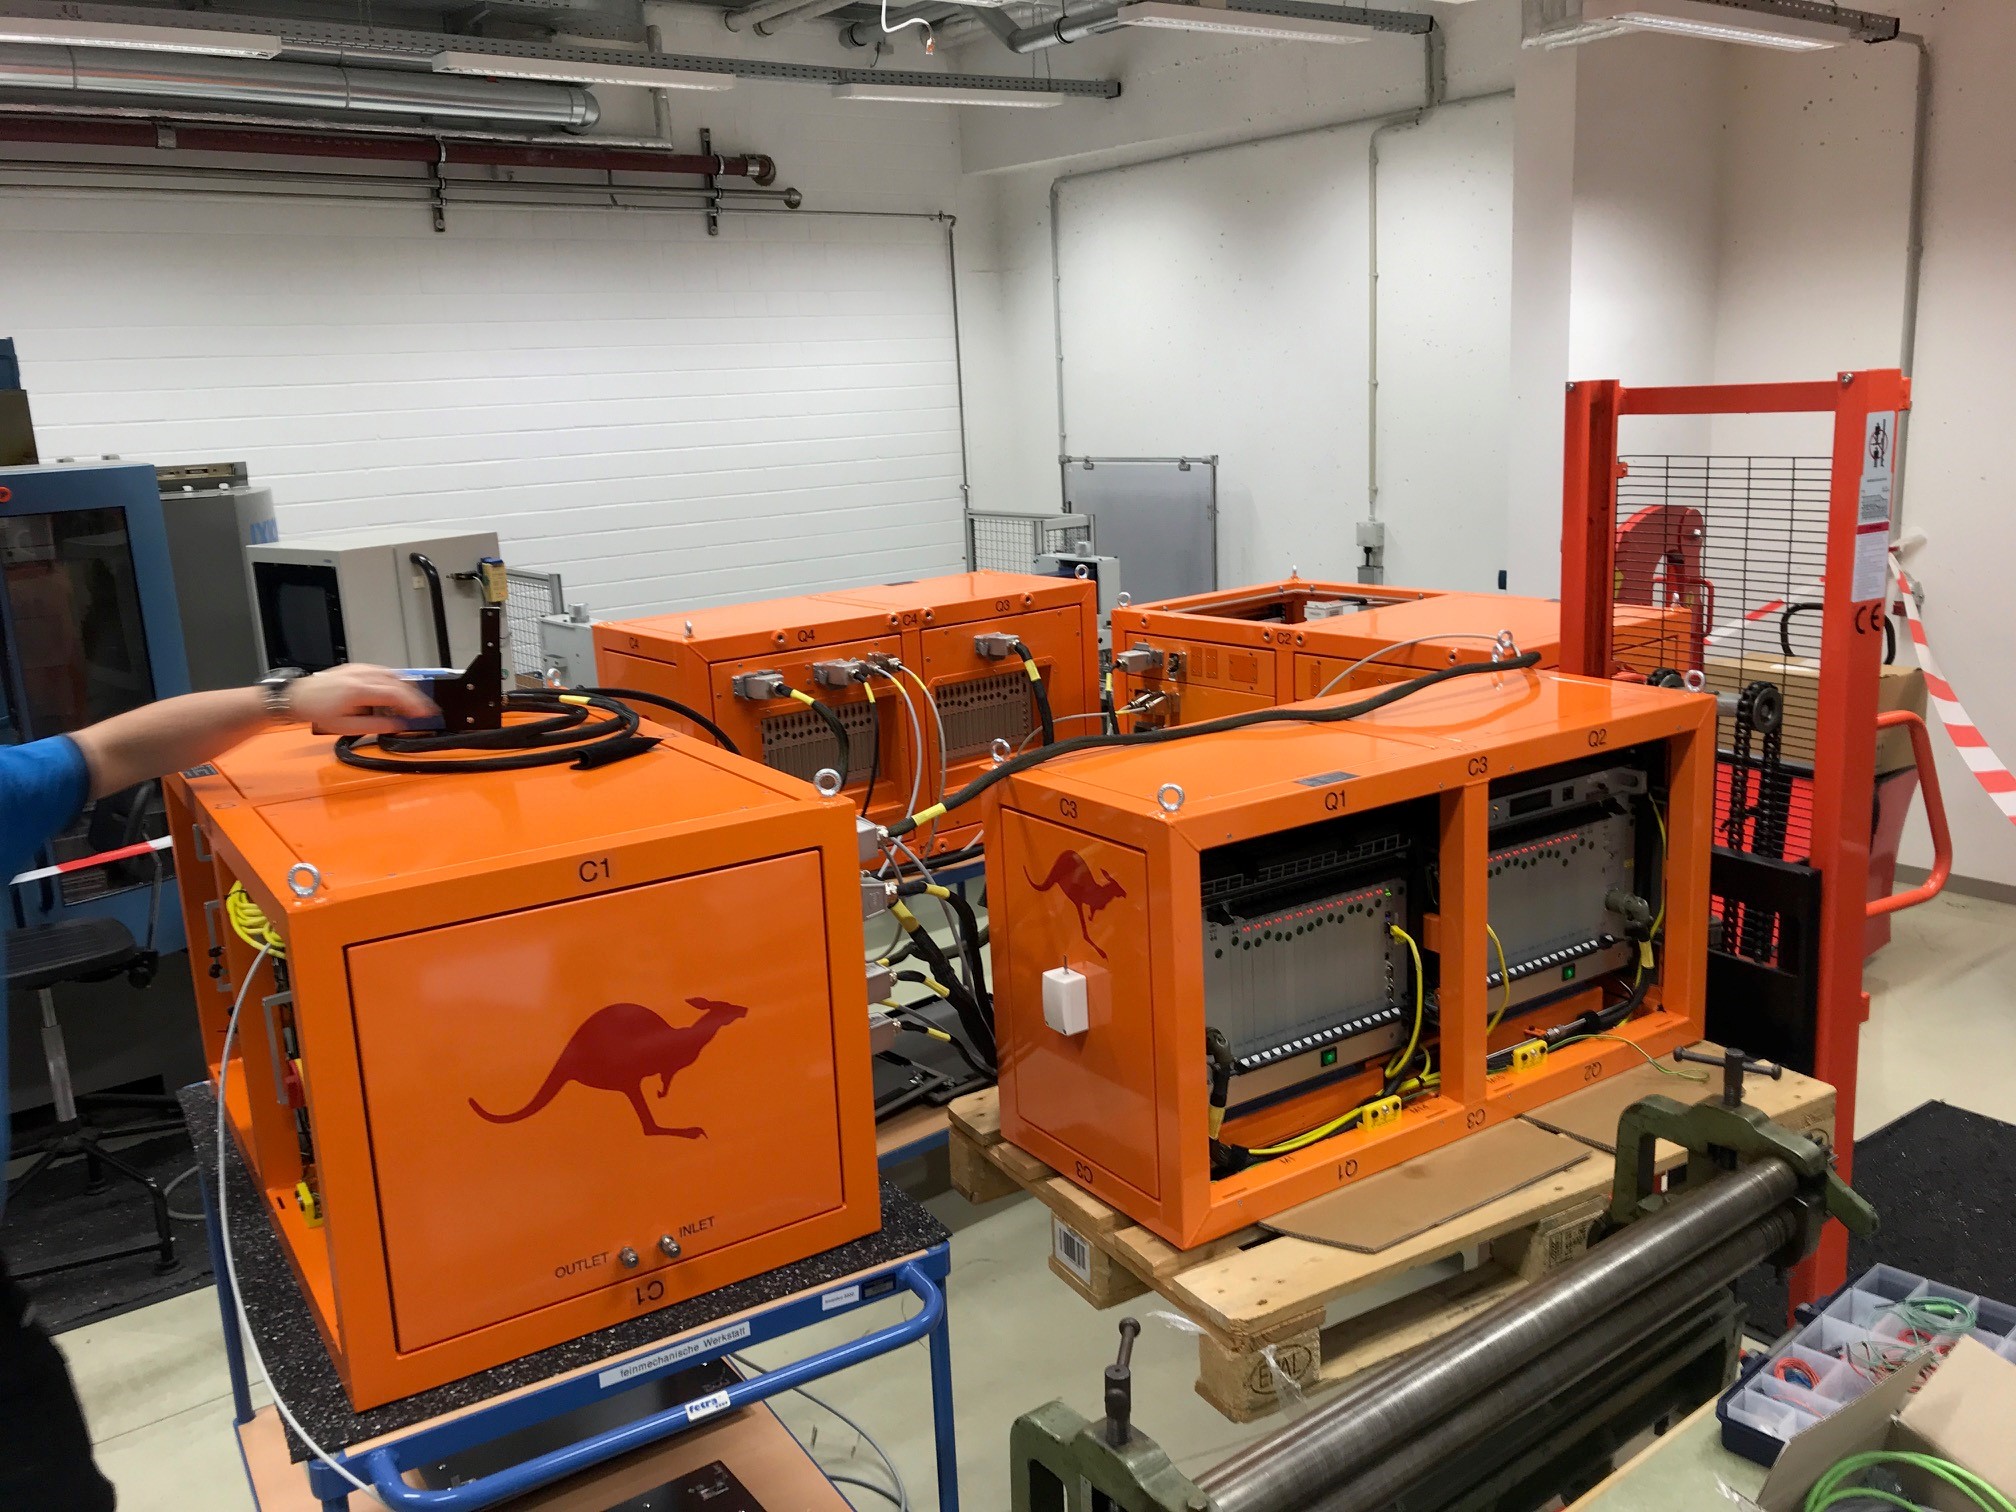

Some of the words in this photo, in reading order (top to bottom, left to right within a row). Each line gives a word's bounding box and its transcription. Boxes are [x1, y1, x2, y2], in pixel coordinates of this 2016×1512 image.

[994, 599, 1011, 612] Q3
[902, 612, 918, 626] C4
[1855, 602, 1882, 635] CE
[797, 628, 816, 643] Q4
[1276, 632, 1292, 645] C2
[1587, 728, 1607, 748] Q2
[1467, 755, 1489, 777] C3
[1059, 797, 1078, 819] C3
[1324, 789, 1346, 811] Q1
[579, 857, 610, 883] C1
[1583, 1061, 1603, 1082] Q2
[1465, 1107, 1486, 1130] C3
[1075, 1160, 1094, 1184] C3
[1337, 1158, 1358, 1181] Q1
[678, 1215, 715, 1238] INLET
[554, 1251, 610, 1279] OUTLET
[635, 1279, 665, 1306] C1
[620, 1344, 700, 1379] feinmechanische
[702, 1327, 747, 1349] Werkstatt
[1258, 1353, 1302, 1389] EAL
[689, 1397, 719, 1415] fetra
